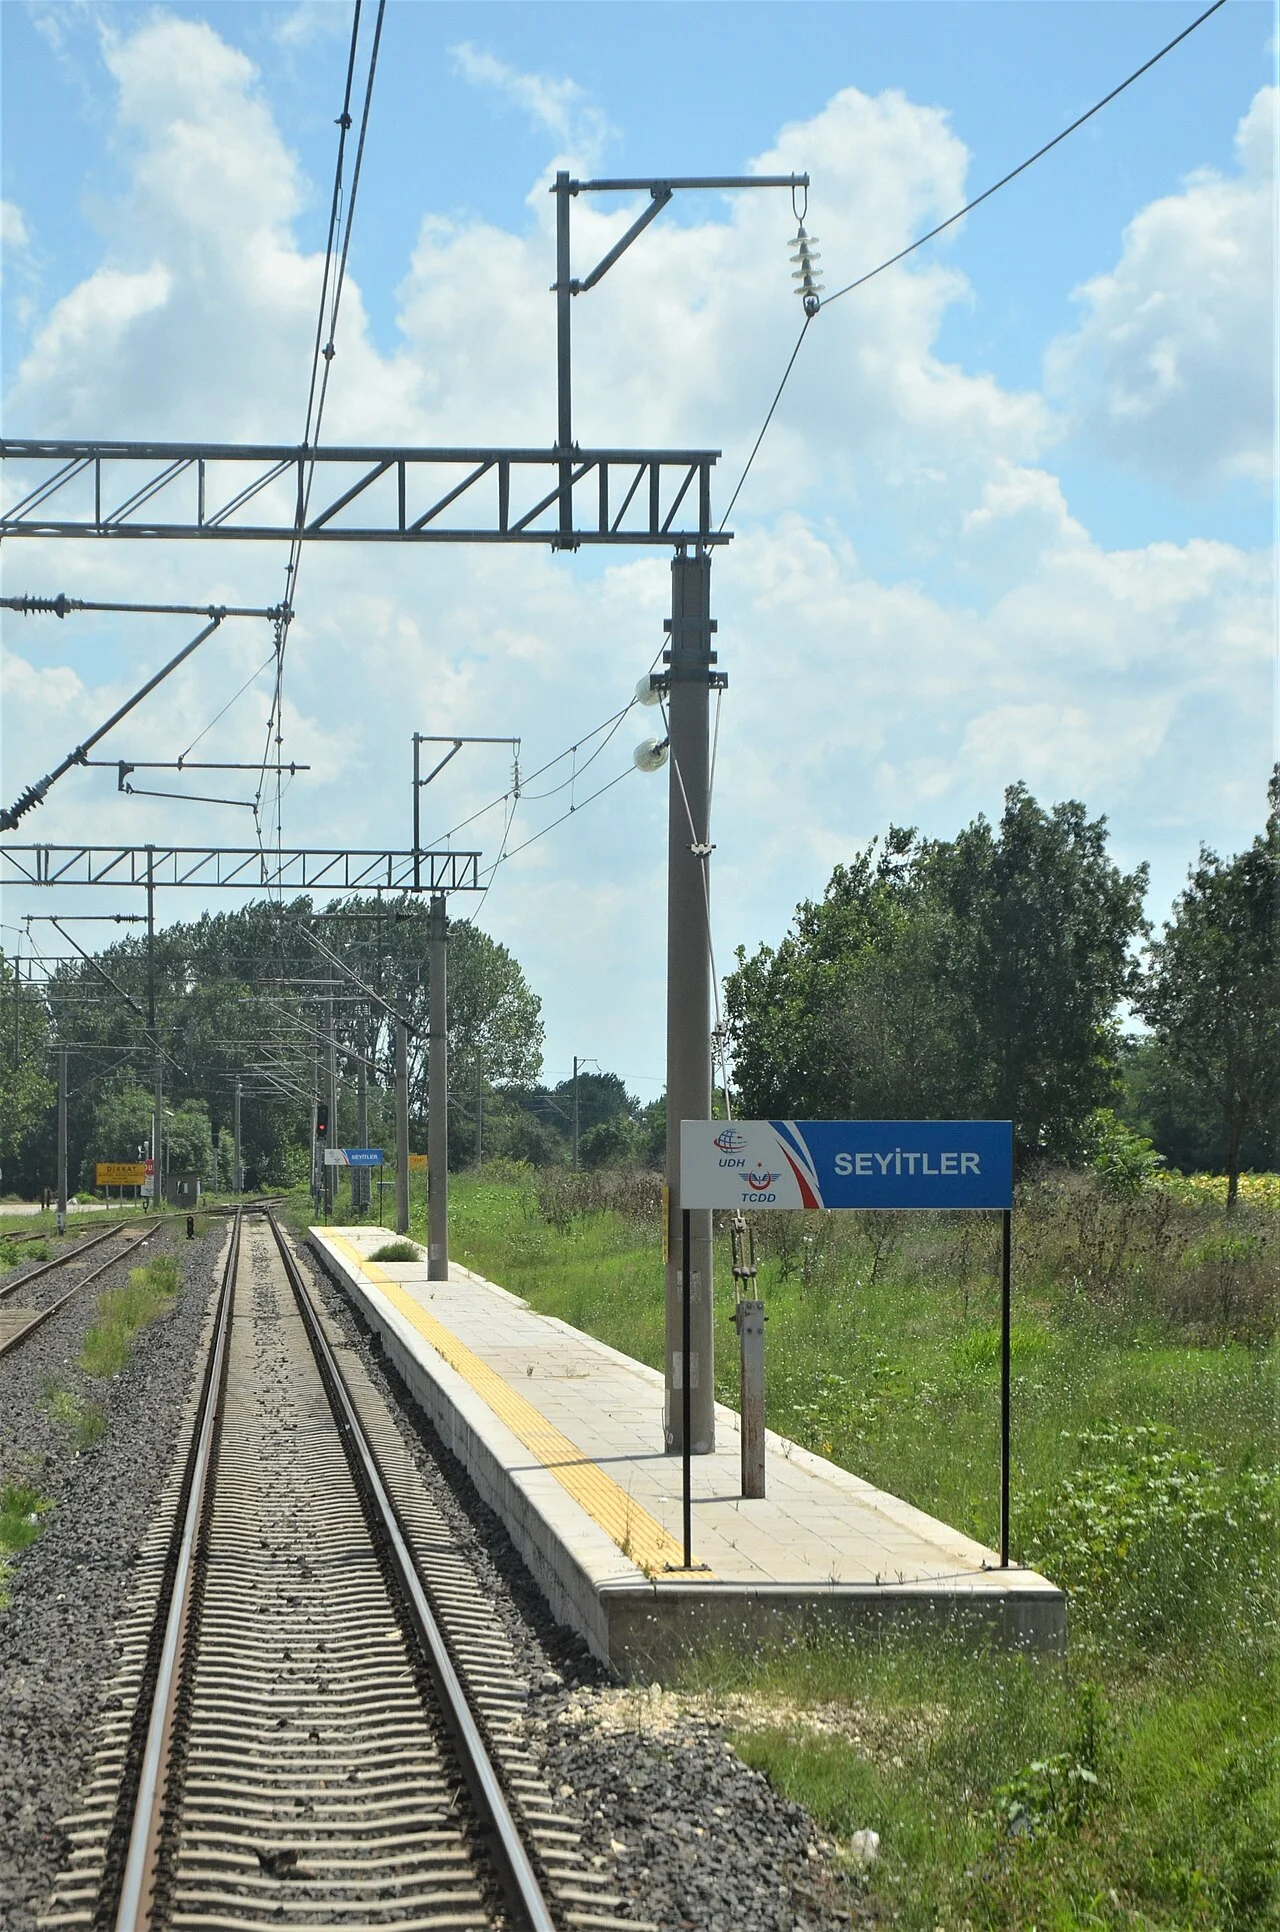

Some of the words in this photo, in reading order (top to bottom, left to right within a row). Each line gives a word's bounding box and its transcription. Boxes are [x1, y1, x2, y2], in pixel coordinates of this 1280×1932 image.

[718, 1158, 746, 1168] UDH
[834, 1148, 981, 1176] SEYİTLER
[741, 1193, 776, 1203] TCDD
